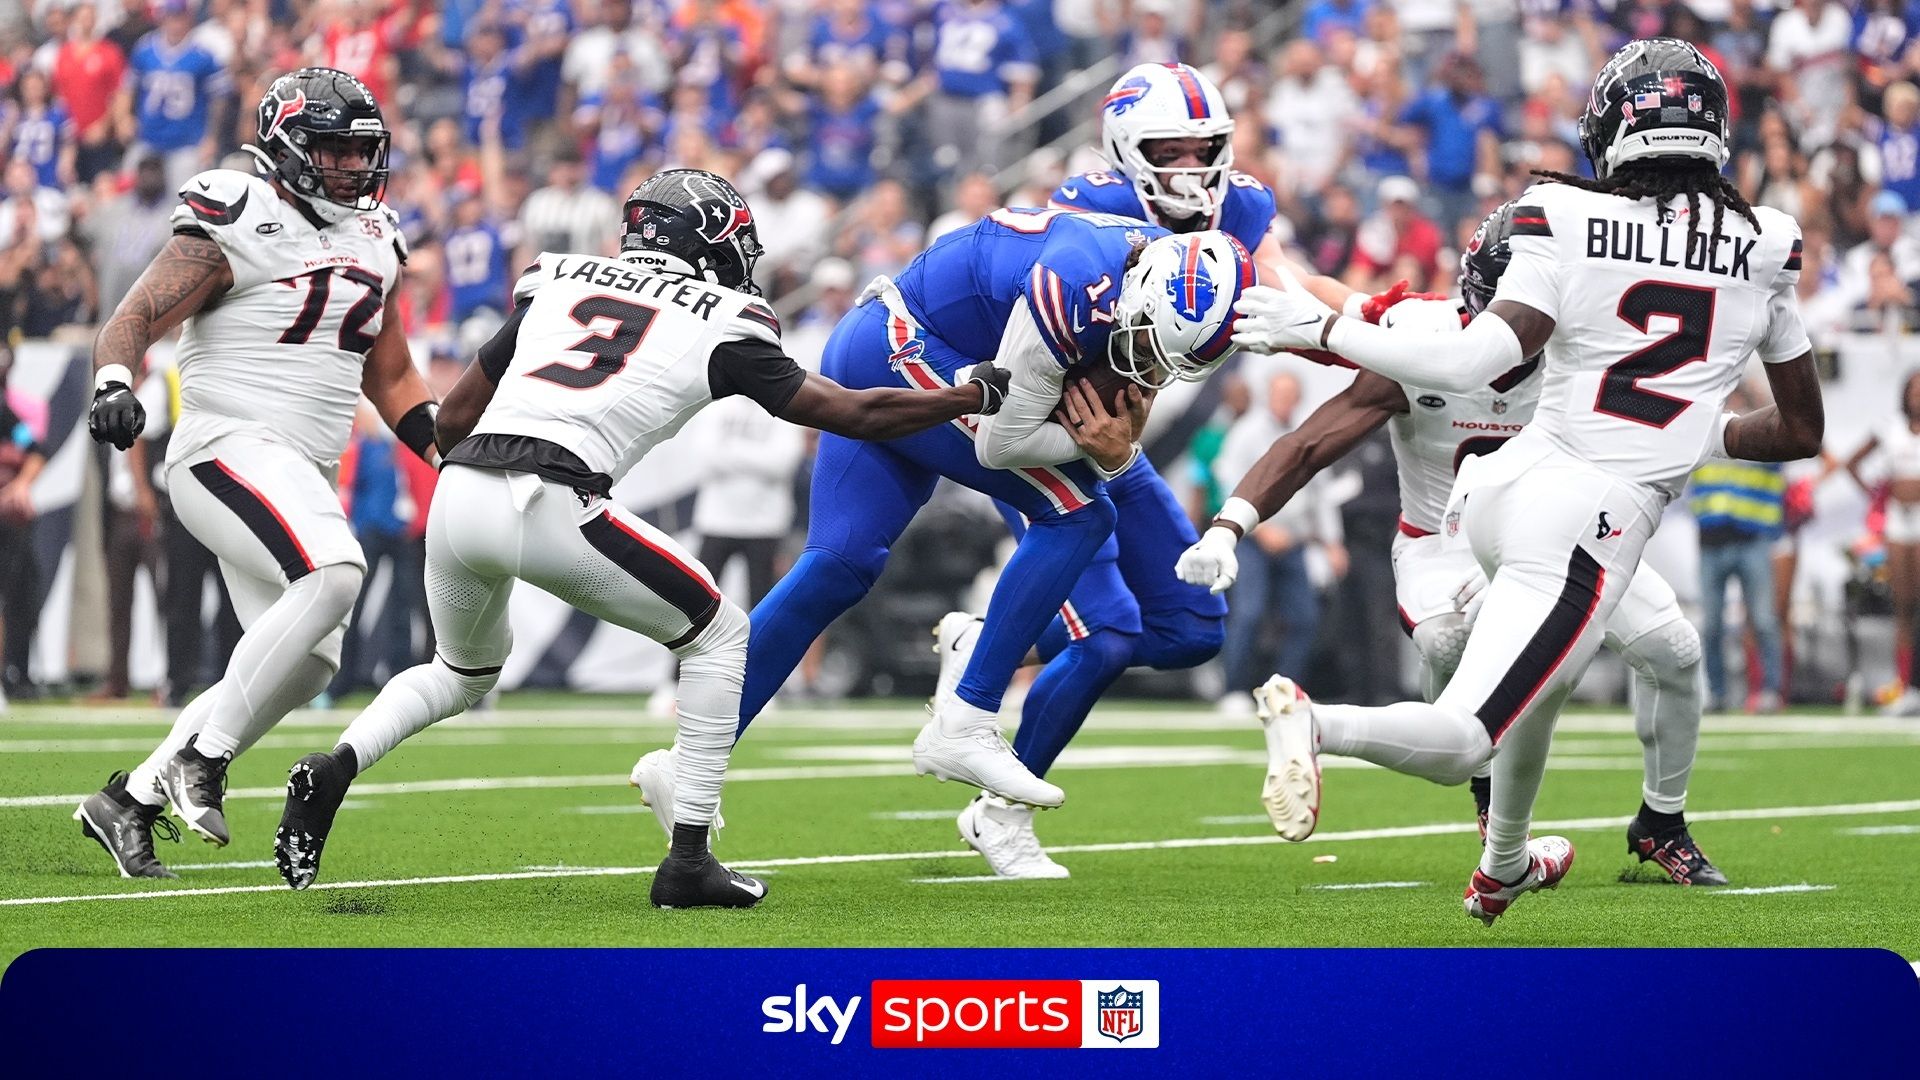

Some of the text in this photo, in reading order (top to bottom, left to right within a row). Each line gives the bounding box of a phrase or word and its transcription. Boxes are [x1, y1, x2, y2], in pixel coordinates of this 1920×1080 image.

[1587, 217, 1757, 281] BULLOCK
[271, 264, 384, 354] 72
[553, 258, 723, 321] LASSITER
[1084, 273, 1117, 324] 17
[521, 293, 661, 391] 3
[1593, 279, 1717, 429] 2
[1452, 420, 1524, 432] HOUSTO
